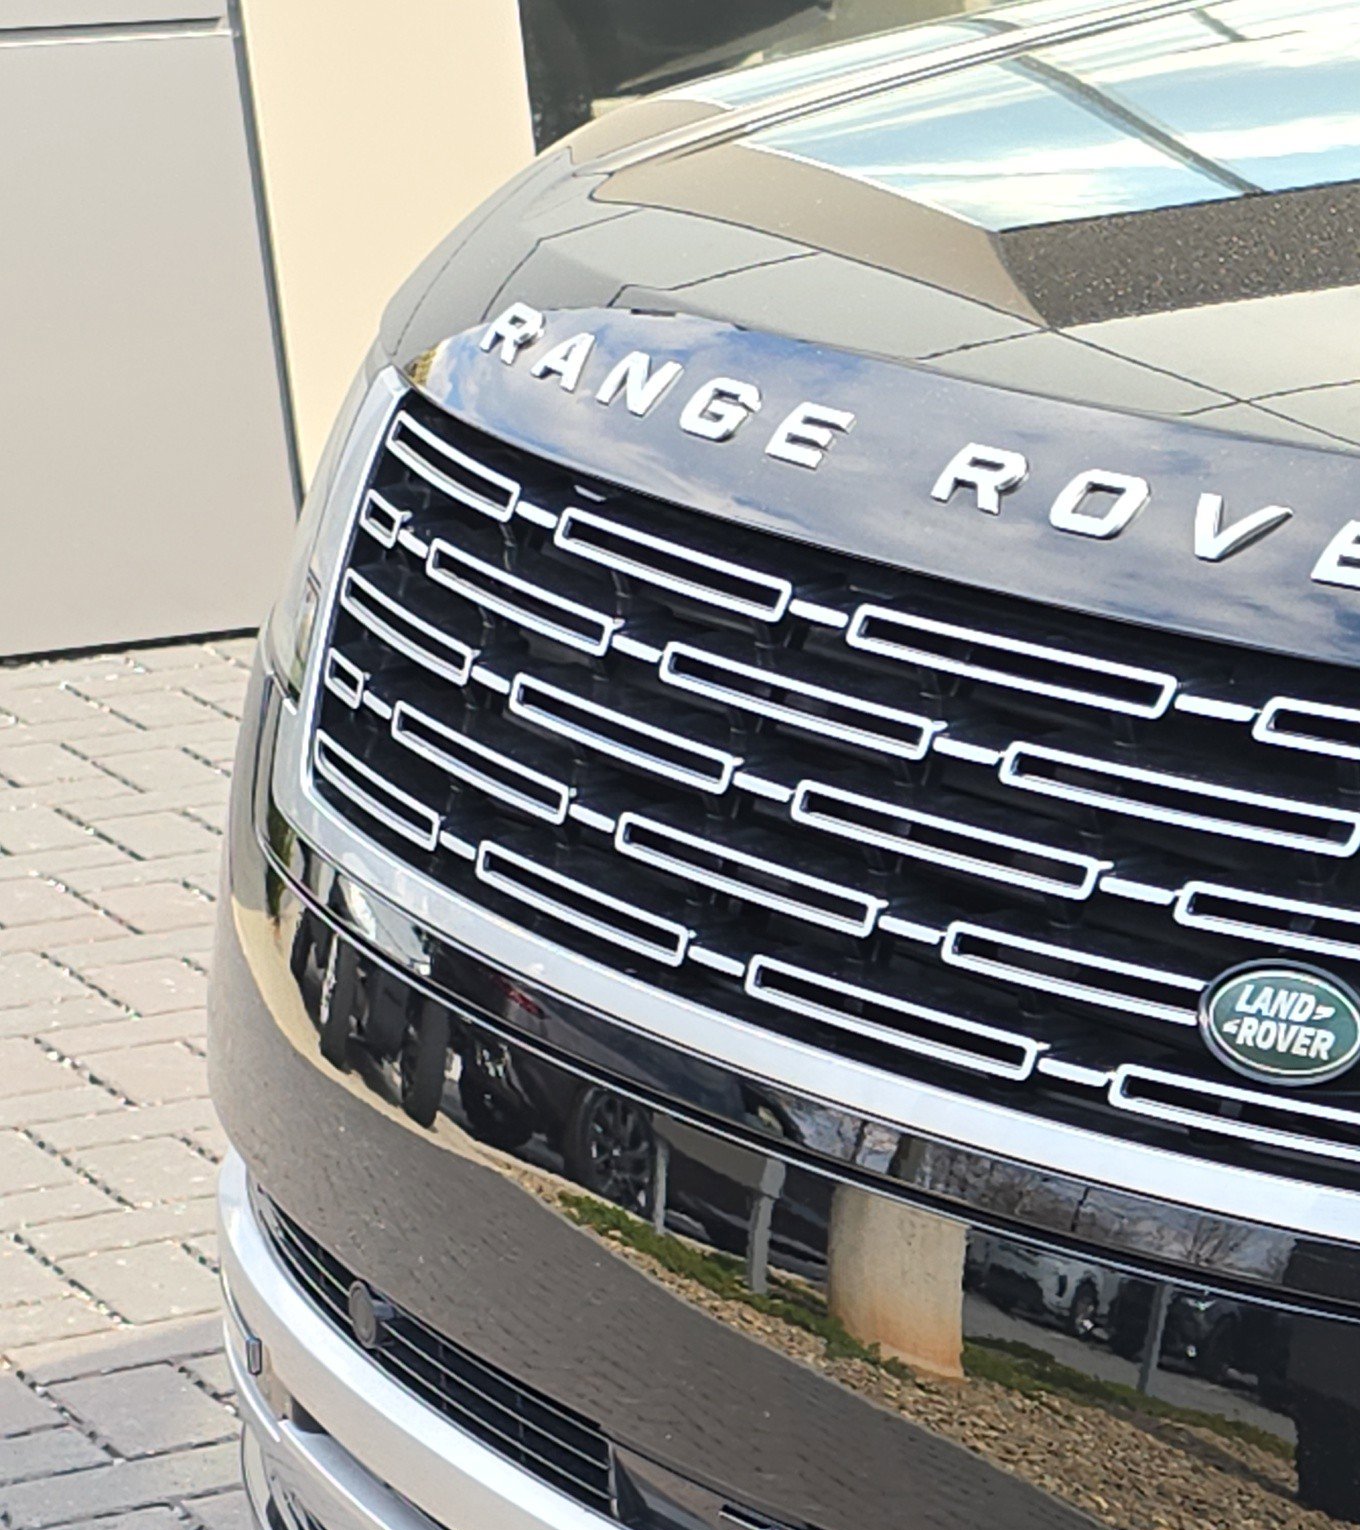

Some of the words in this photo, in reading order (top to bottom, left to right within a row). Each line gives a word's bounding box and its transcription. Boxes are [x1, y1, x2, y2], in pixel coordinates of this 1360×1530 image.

[480, 302, 857, 470] RANGE
[1235, 984, 1317, 1022] LAND
[1236, 1017, 1336, 1061] ROVER
